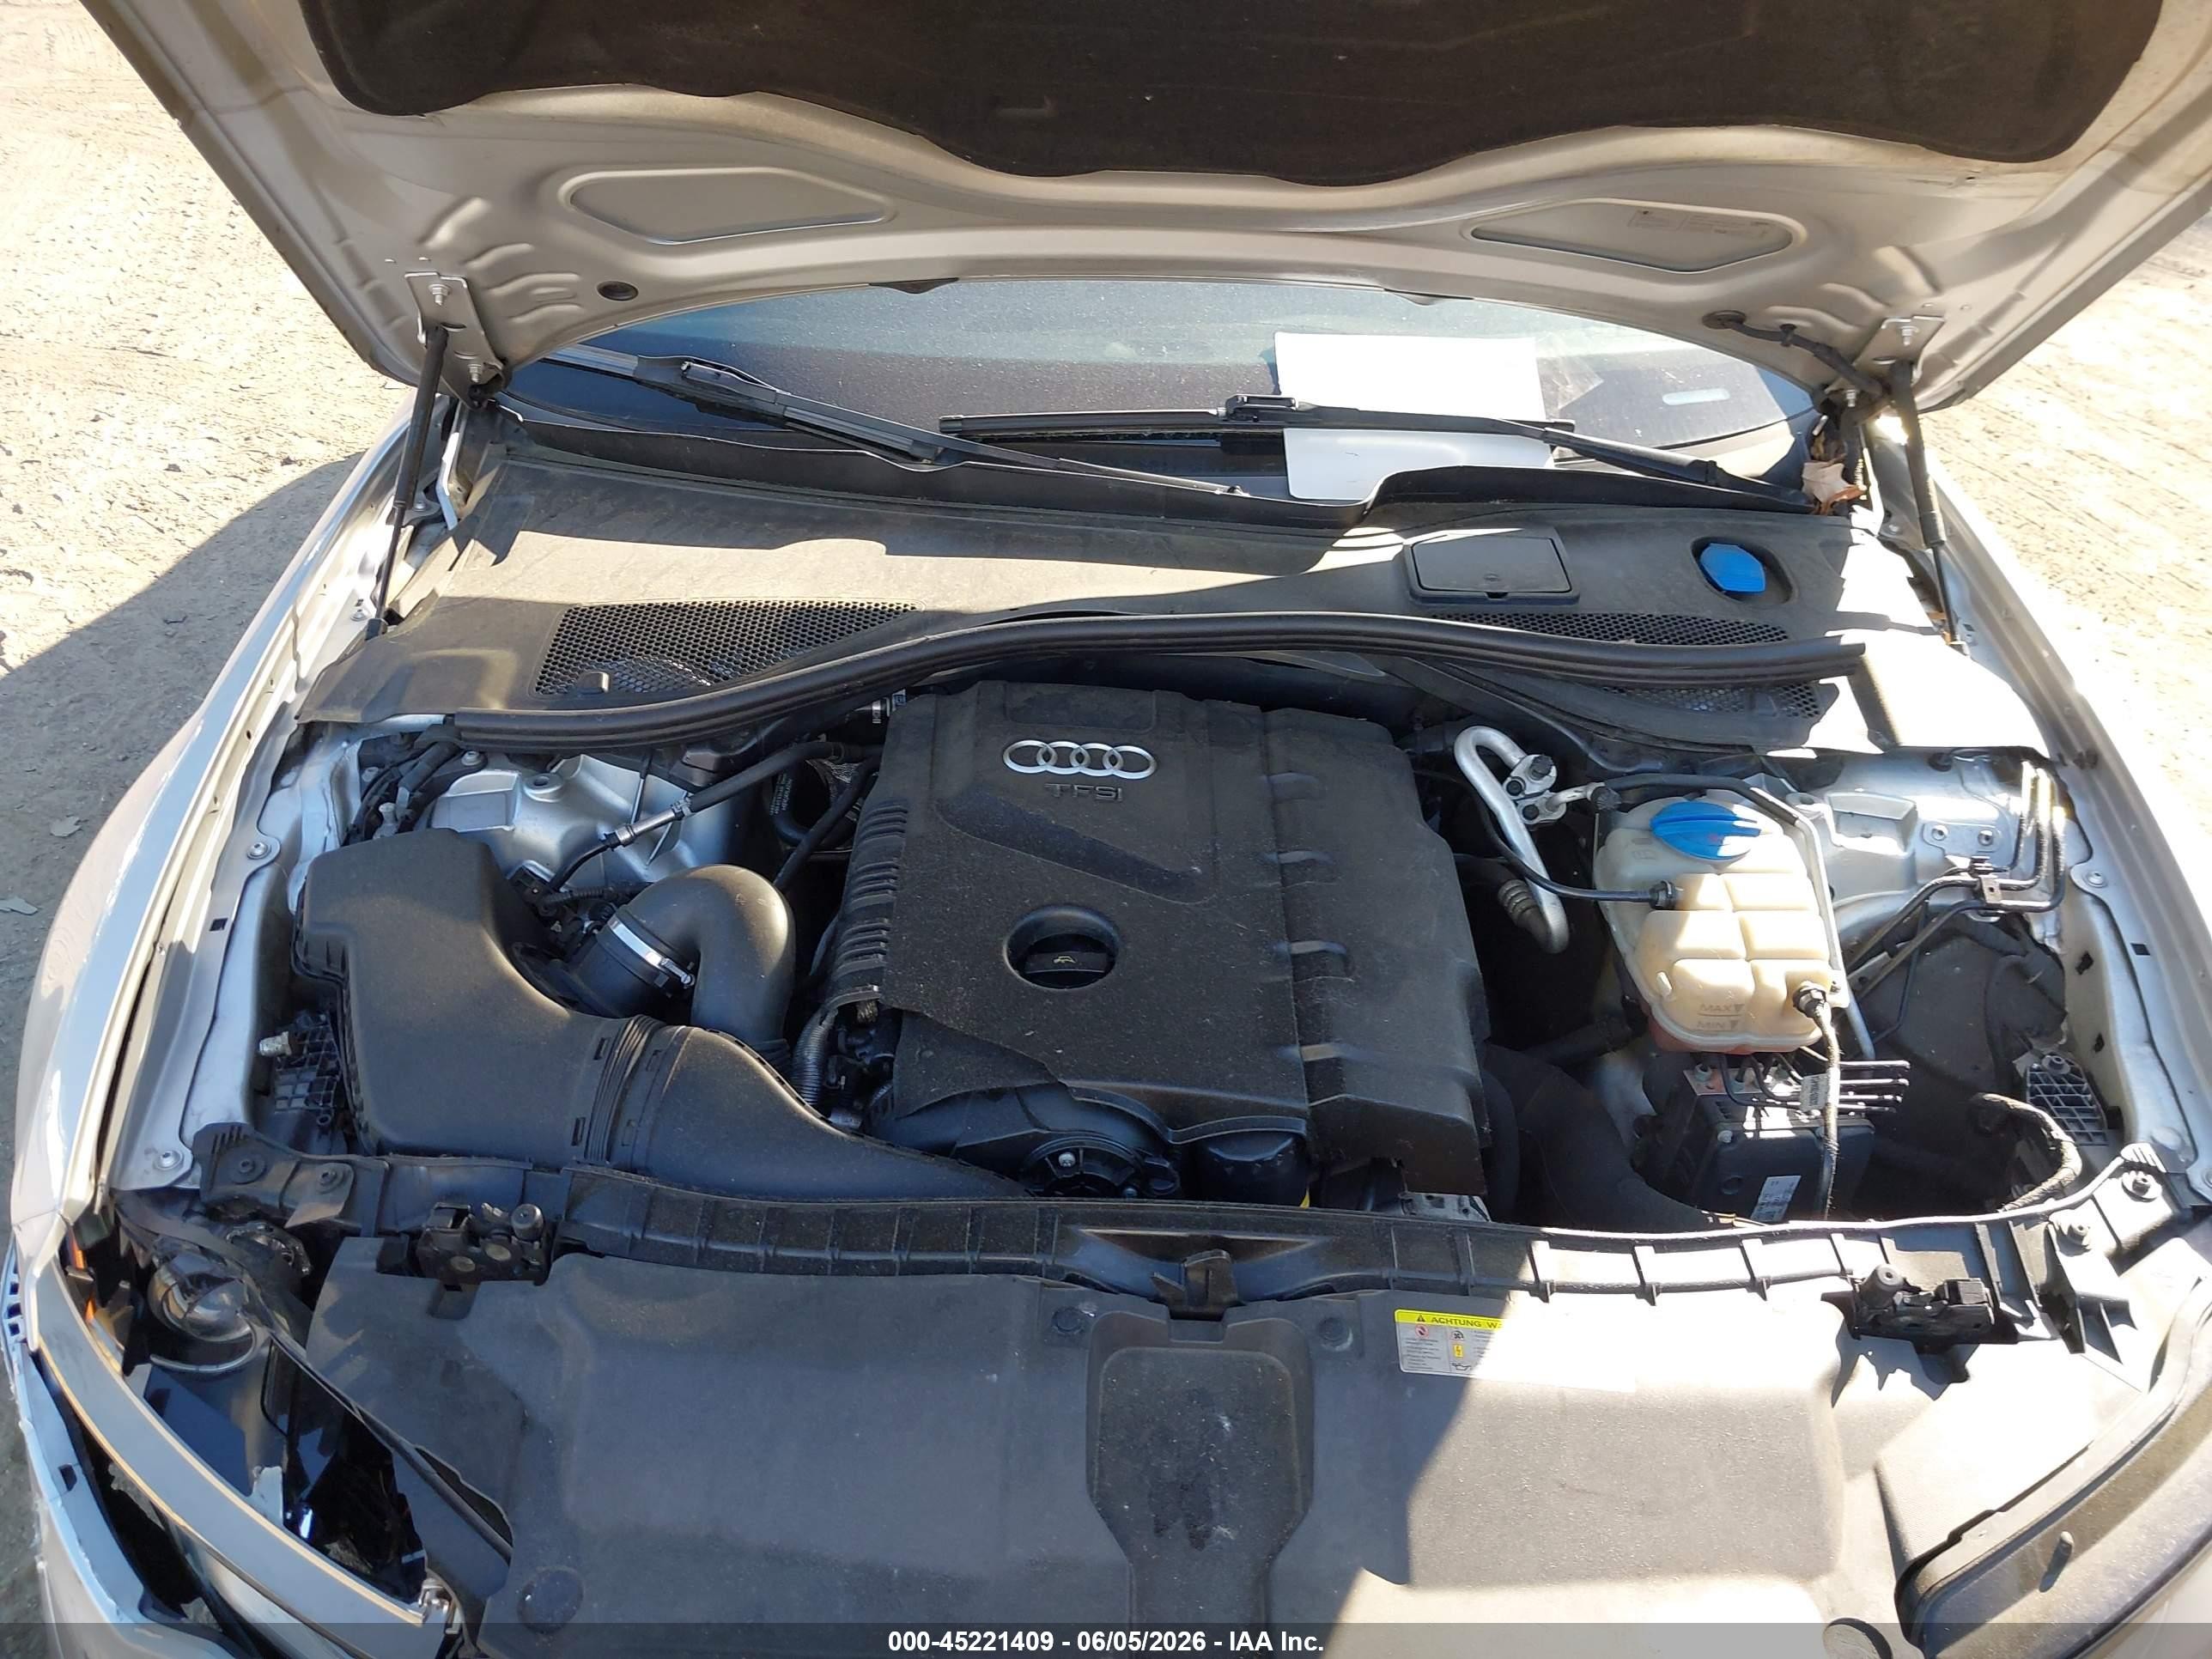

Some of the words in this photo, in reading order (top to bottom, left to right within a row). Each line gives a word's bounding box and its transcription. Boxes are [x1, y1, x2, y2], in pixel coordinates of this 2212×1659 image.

[1044, 782, 1123, 802] TFSI
[1699, 1002, 1733, 1012] MAX
[1431, 1316, 1482, 1328] ACHTUNG
